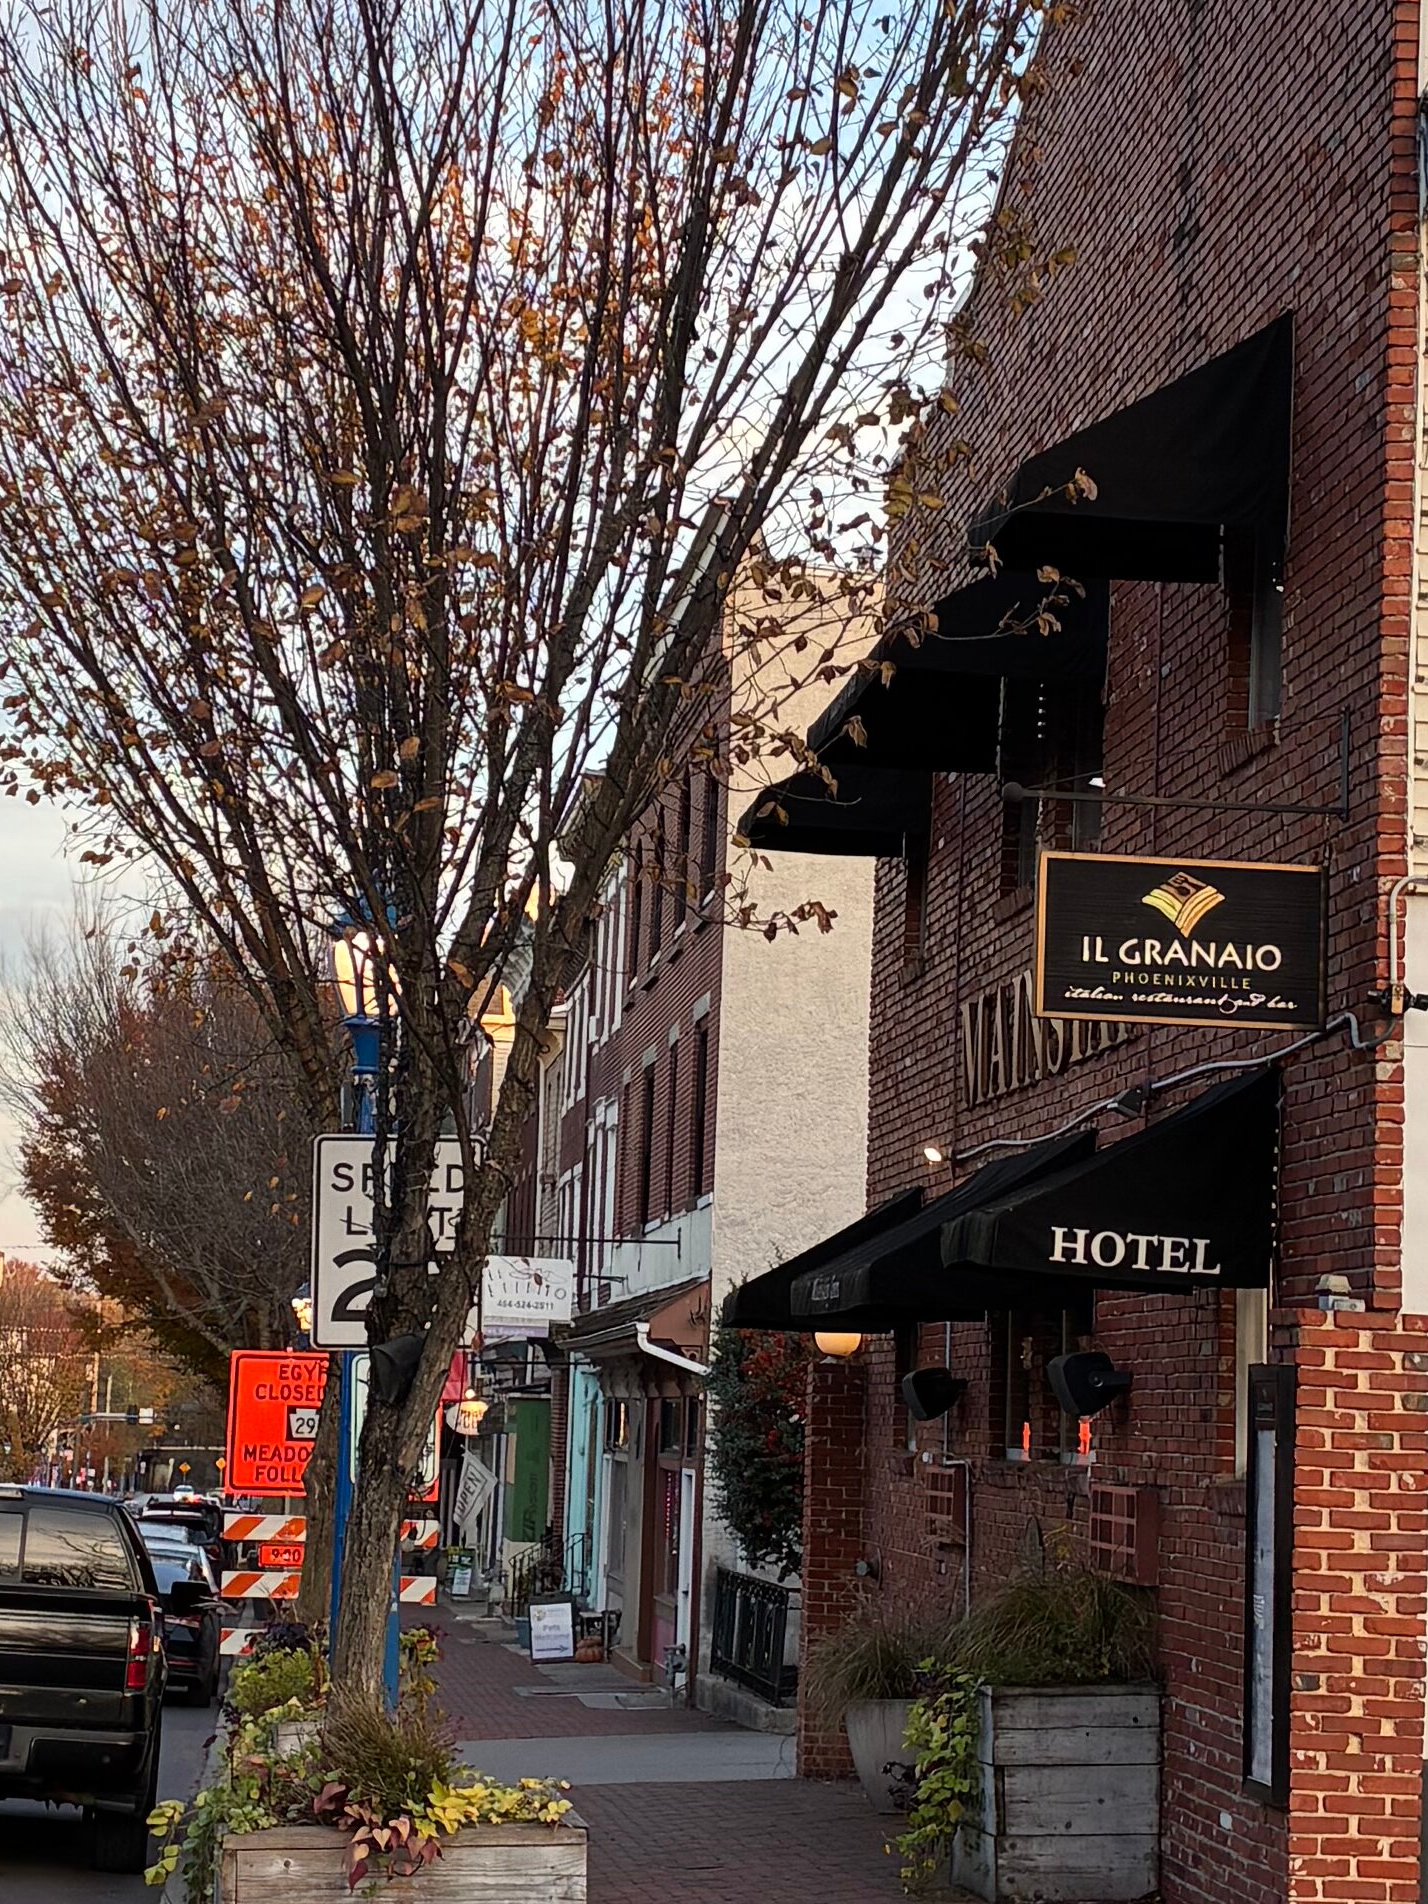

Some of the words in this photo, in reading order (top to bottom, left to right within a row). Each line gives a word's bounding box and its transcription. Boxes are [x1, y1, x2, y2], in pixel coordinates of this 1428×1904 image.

[1082, 936, 1109, 963] IL
[1118, 938, 1282, 971] GRANAIO
[1112, 971, 1251, 990] PHOENIXVILLE
[1064, 986, 1124, 1000] italian
[1131, 992, 1238, 1014] restaurant
[1235, 994, 1267, 1007] and
[1266, 996, 1298, 1009] bar
[1049, 1226, 1221, 1274] HOTEL
[279, 1362, 328, 1382] EGYP
[295, 1417, 316, 1434] 29
[243, 1444, 312, 1463] MEADO
[254, 1465, 301, 1483] FOLL
